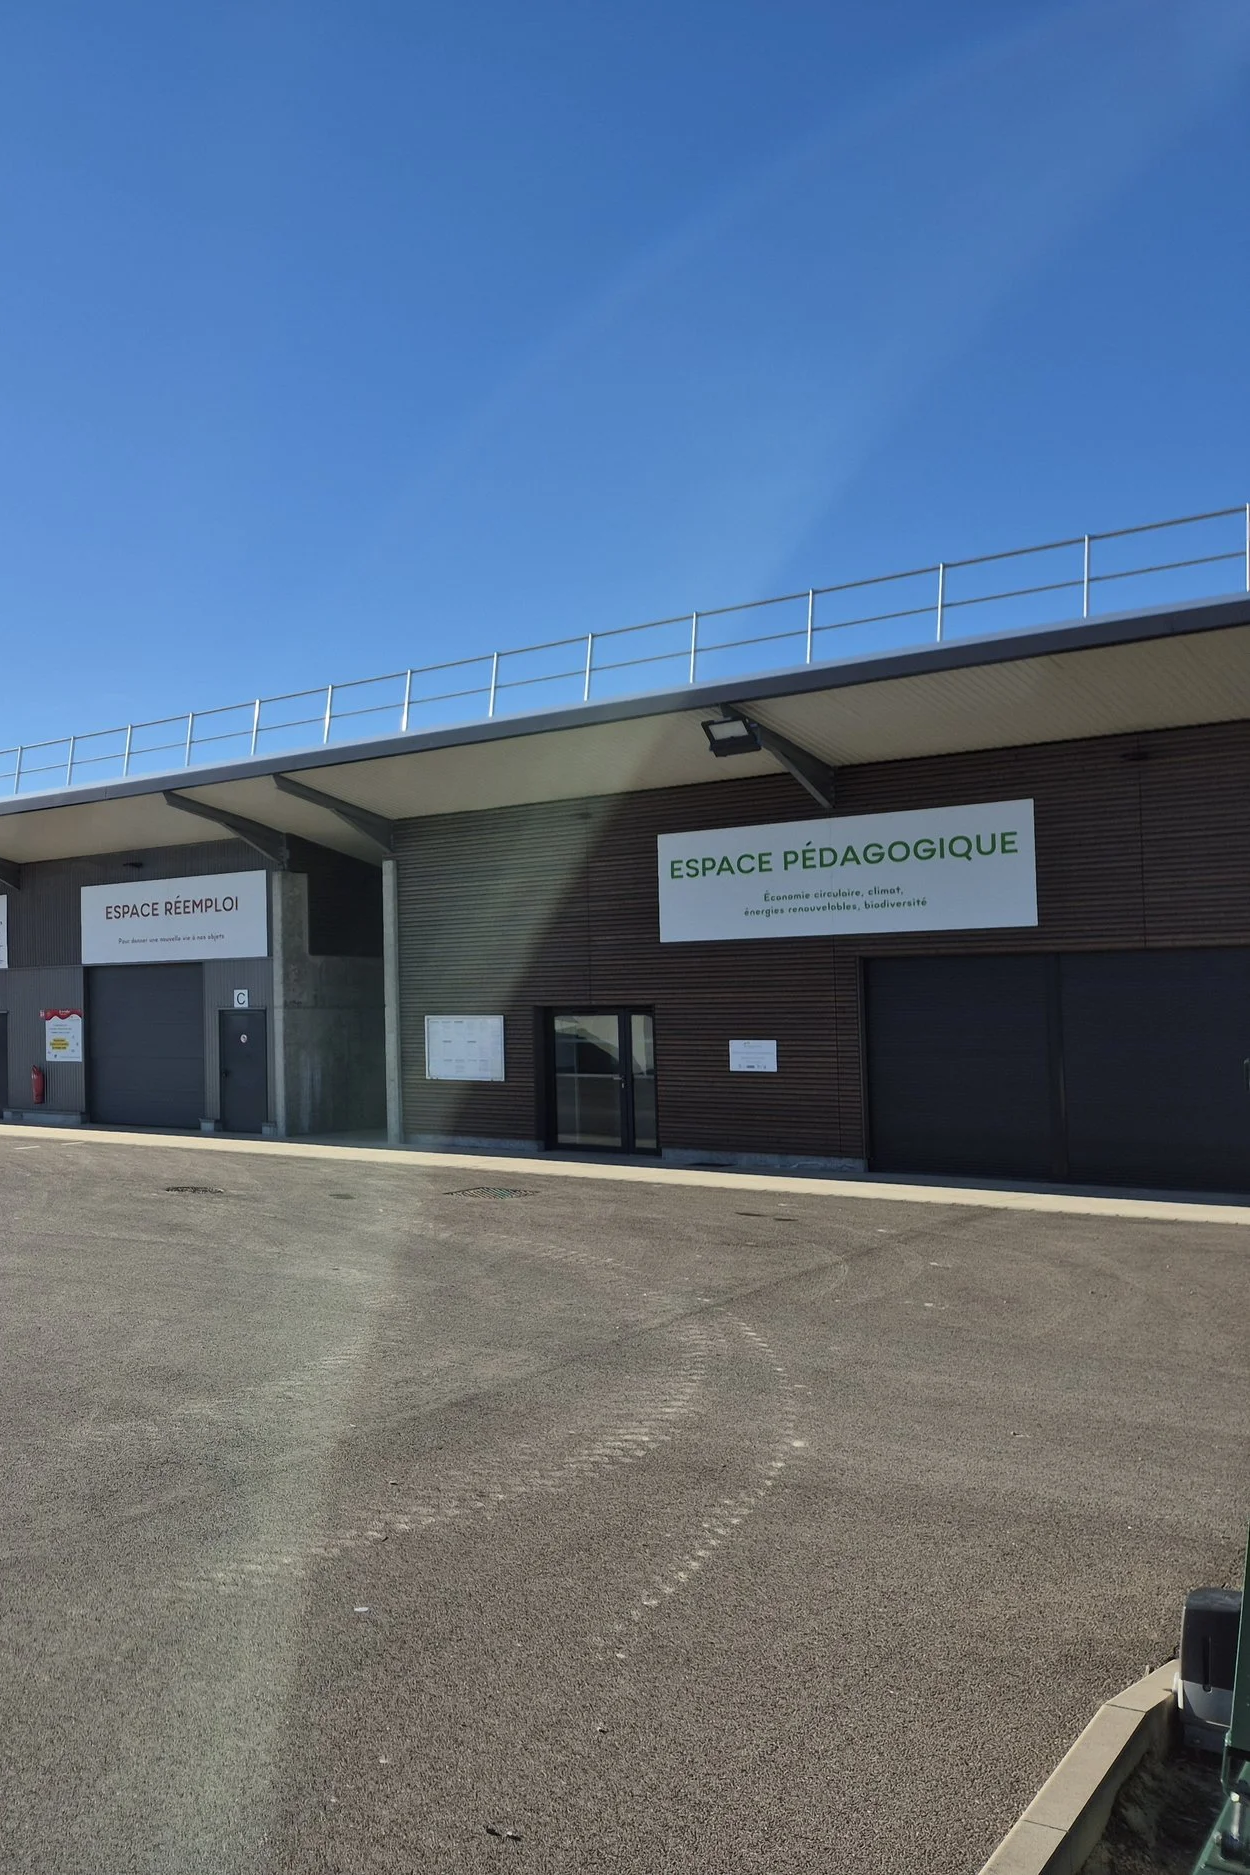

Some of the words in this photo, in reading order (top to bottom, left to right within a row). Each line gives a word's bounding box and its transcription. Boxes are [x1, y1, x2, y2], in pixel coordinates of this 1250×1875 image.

[669, 852, 772, 879] ESPACE
[783, 831, 1018, 871] PÉDAGOGIQUE
[763, 889, 810, 902] Économie
[814, 888, 864, 899] circulaire,
[868, 886, 904, 896] climat,
[105, 902, 159, 920] ESPACE
[164, 895, 238, 916] RÉEMPLOI
[744, 906, 784, 918] énergies
[788, 902, 860, 914] renouvelables,
[864, 897, 927, 910] biodiversité
[208, 933, 225, 941] objets
[237, 992, 246, 1005] C
